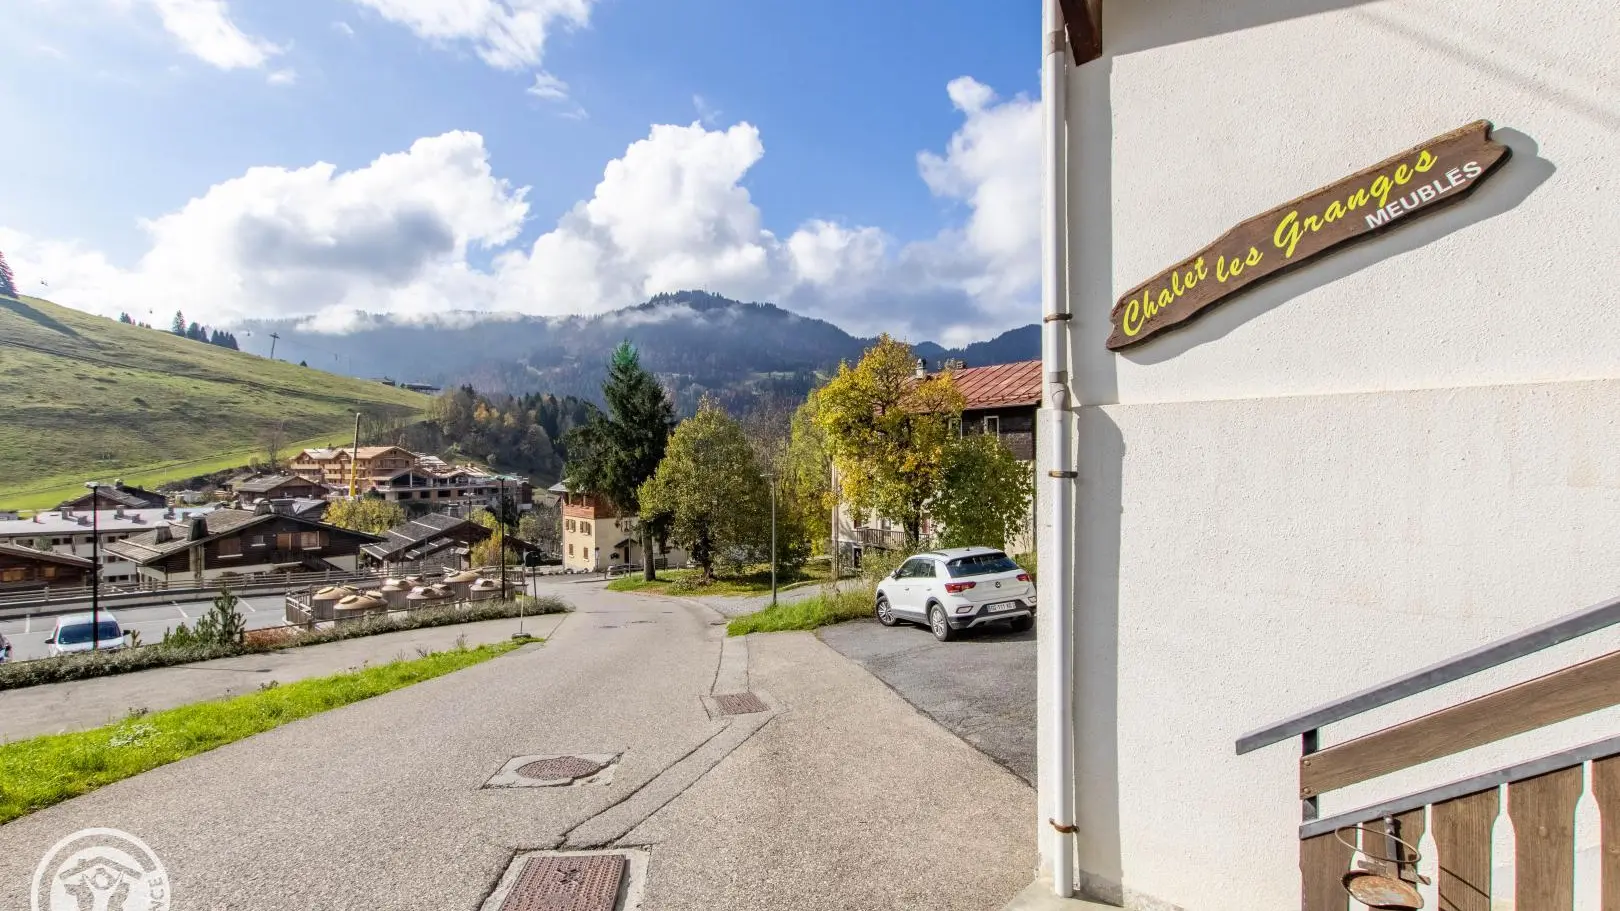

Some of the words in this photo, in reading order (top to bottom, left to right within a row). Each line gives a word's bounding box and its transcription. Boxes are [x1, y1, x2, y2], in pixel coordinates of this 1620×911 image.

[1122, 257, 1208, 337] Chalet
[1215, 245, 1263, 283] les
[1273, 149, 1438, 258] Granges
